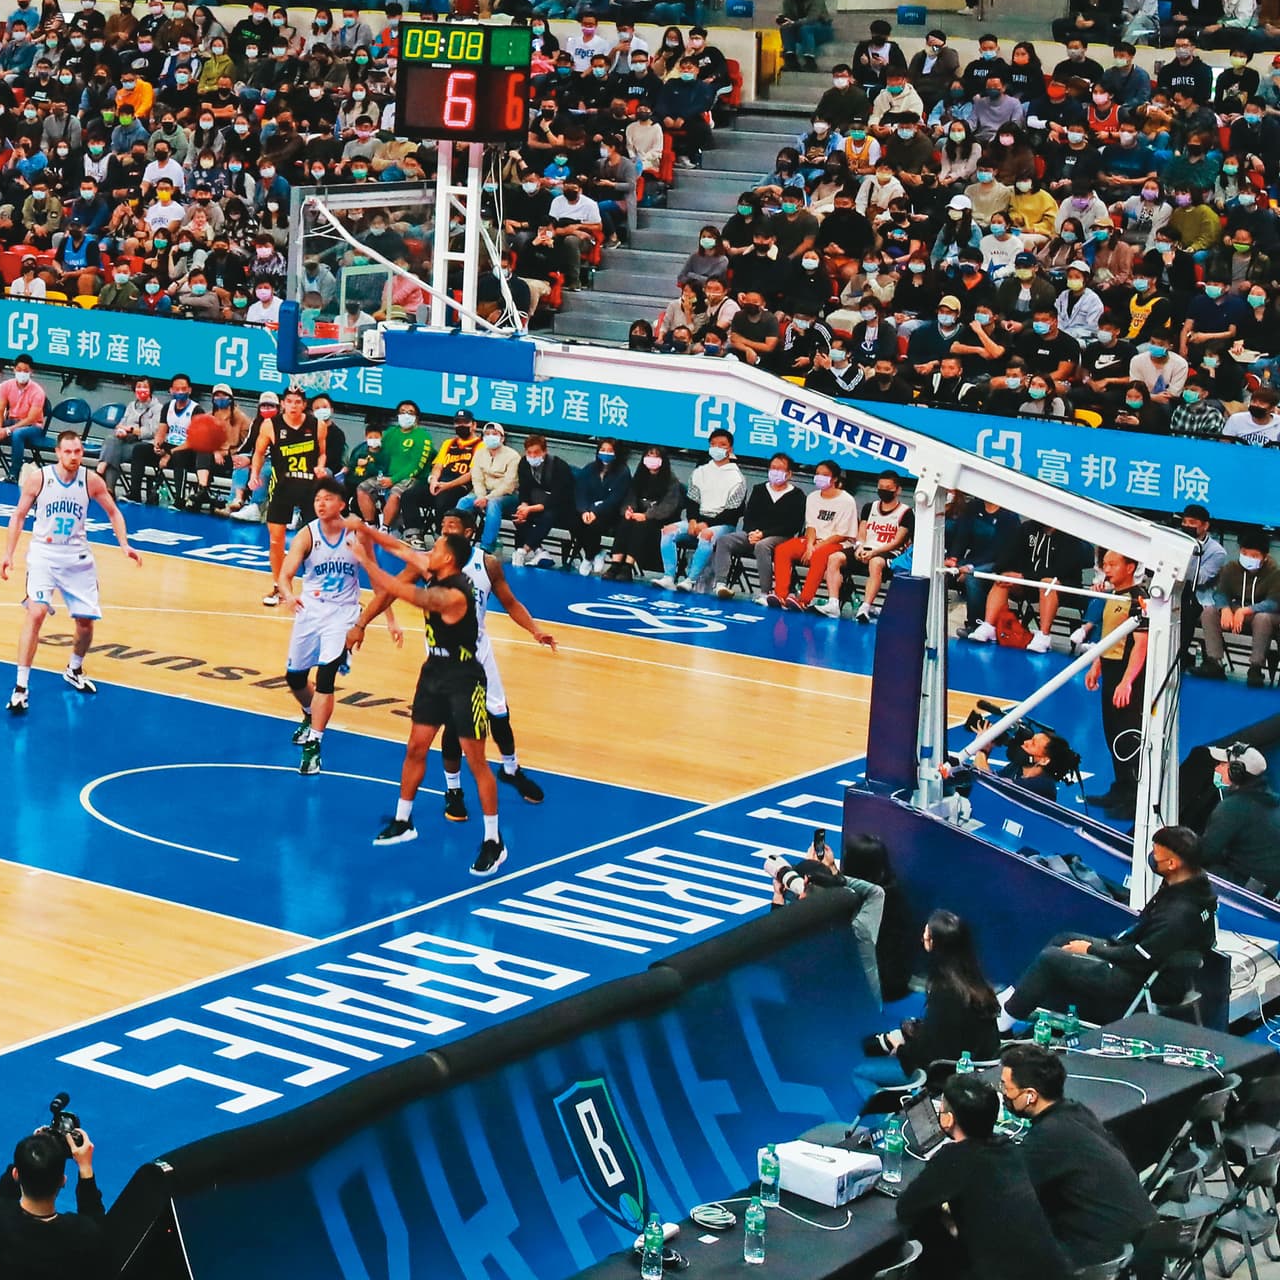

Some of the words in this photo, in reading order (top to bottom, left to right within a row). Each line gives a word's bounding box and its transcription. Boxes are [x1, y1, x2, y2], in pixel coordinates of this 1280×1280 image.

[404, 28, 484, 61] 09:08
[443, 71, 476, 128] 6
[505, 72, 526, 131] 6
[47, 326, 162, 368] 富邦產險
[258, 347, 384, 396] 富投信
[490, 380, 629, 429] 富邦產險
[780, 398, 908, 464] GARED
[288, 456, 309, 473] 24
[1036, 449, 1212, 504] 富邦產險
[45, 499, 84, 521] BRAVES
[53, 516, 75, 536] 32
[314, 560, 355, 578] BRAVES
[54, 930, 591, 1114] BRAVES
